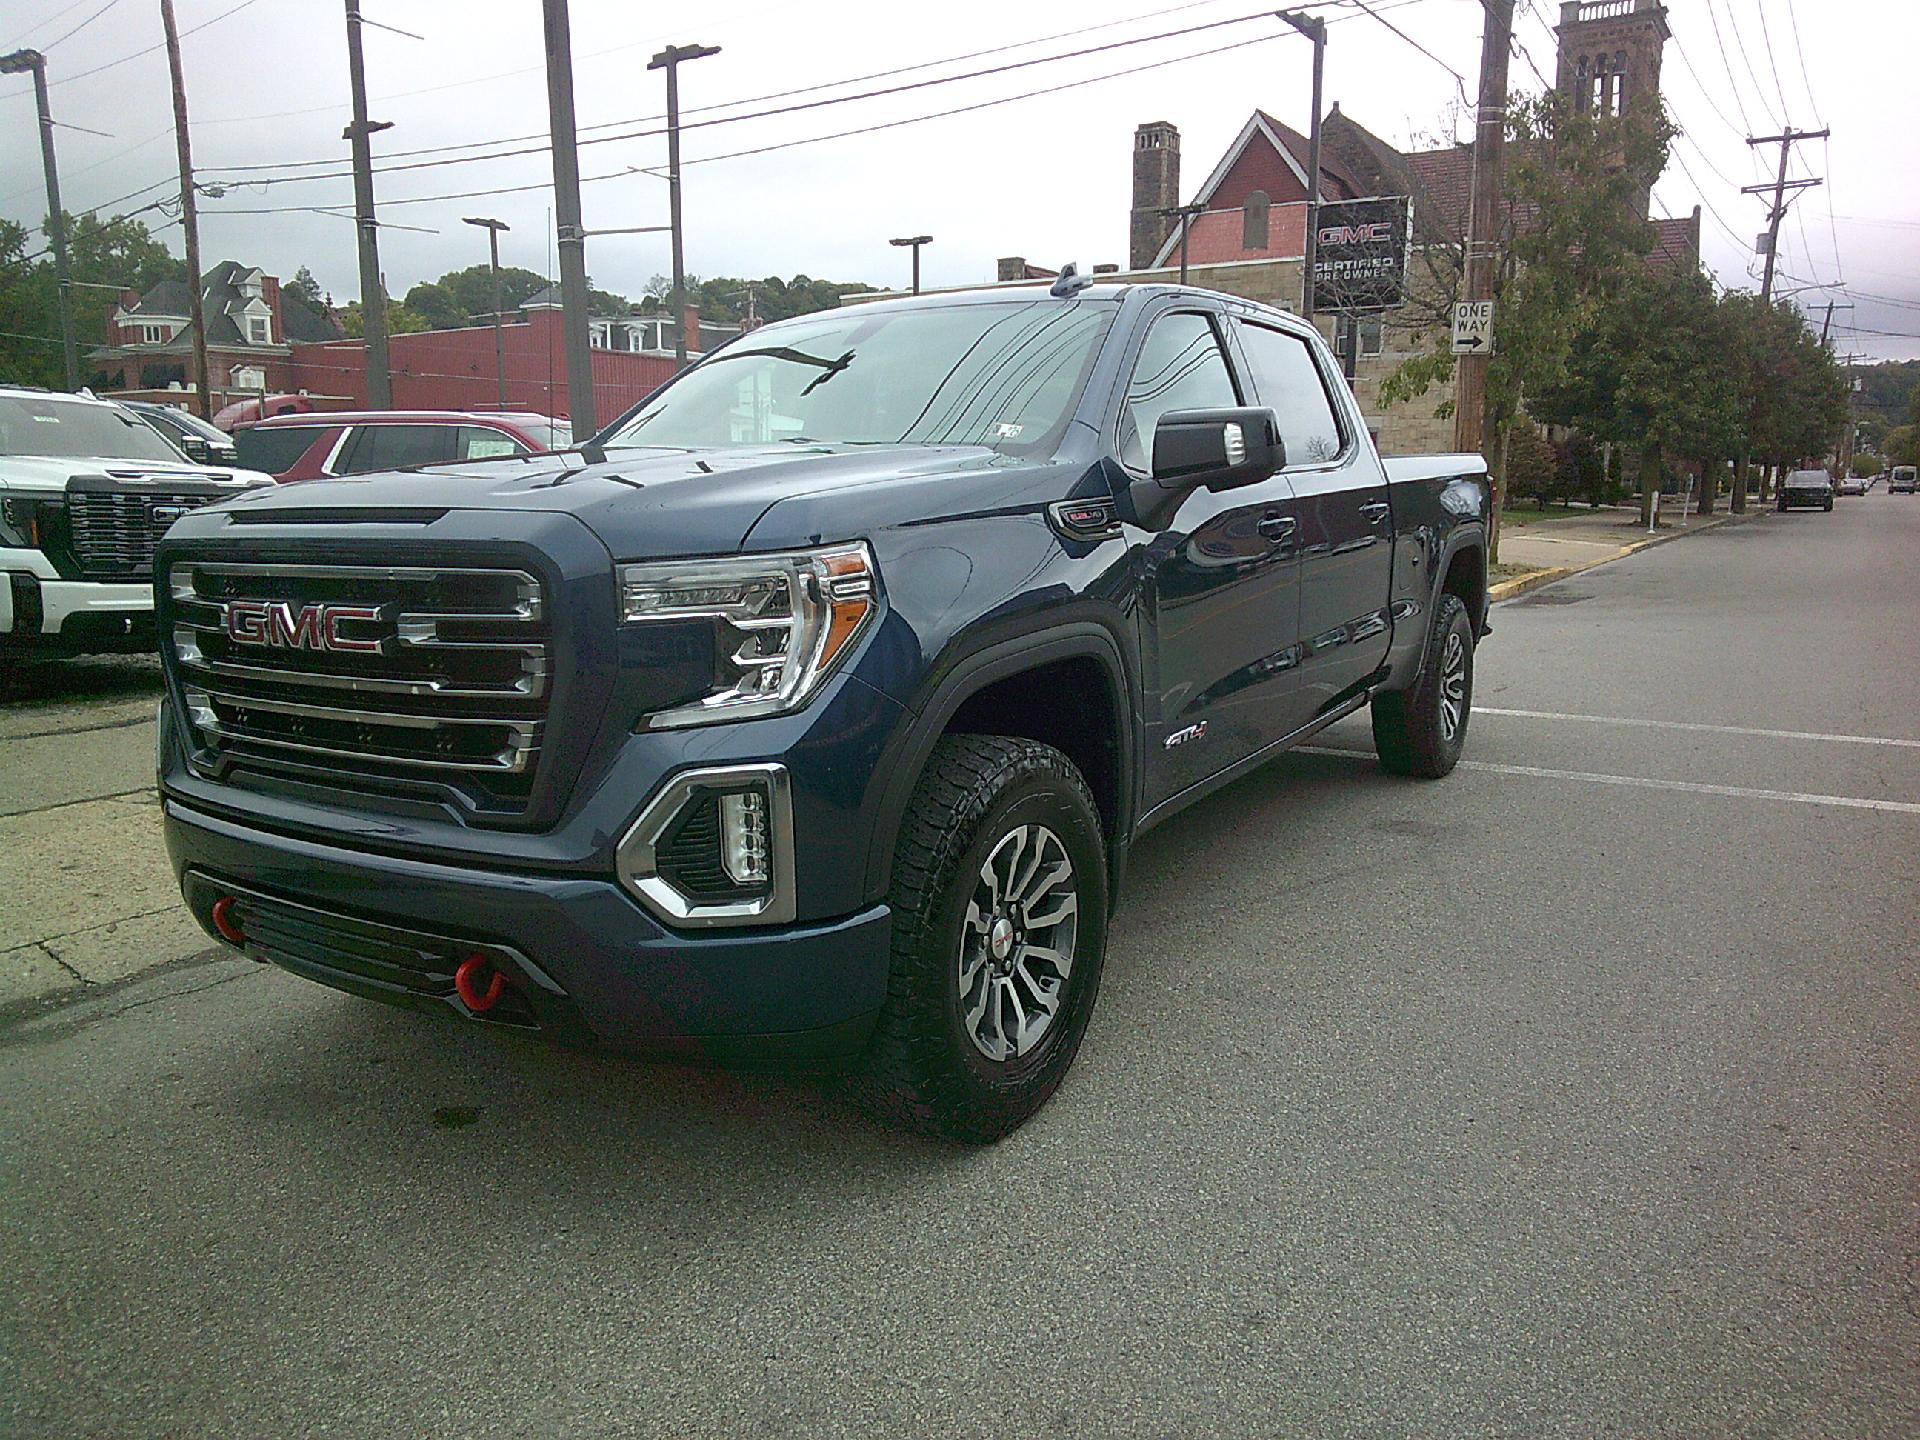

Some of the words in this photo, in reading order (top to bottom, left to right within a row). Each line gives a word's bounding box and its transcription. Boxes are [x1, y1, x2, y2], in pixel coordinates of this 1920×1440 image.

[1319, 222, 1392, 246] GMC
[1314, 257, 1394, 272] CERTIFIED
[1459, 305, 1488, 318] ONE
[1457, 320, 1488, 332] WAY
[228, 601, 382, 654] GMC
[1163, 720, 1208, 750] AT4
